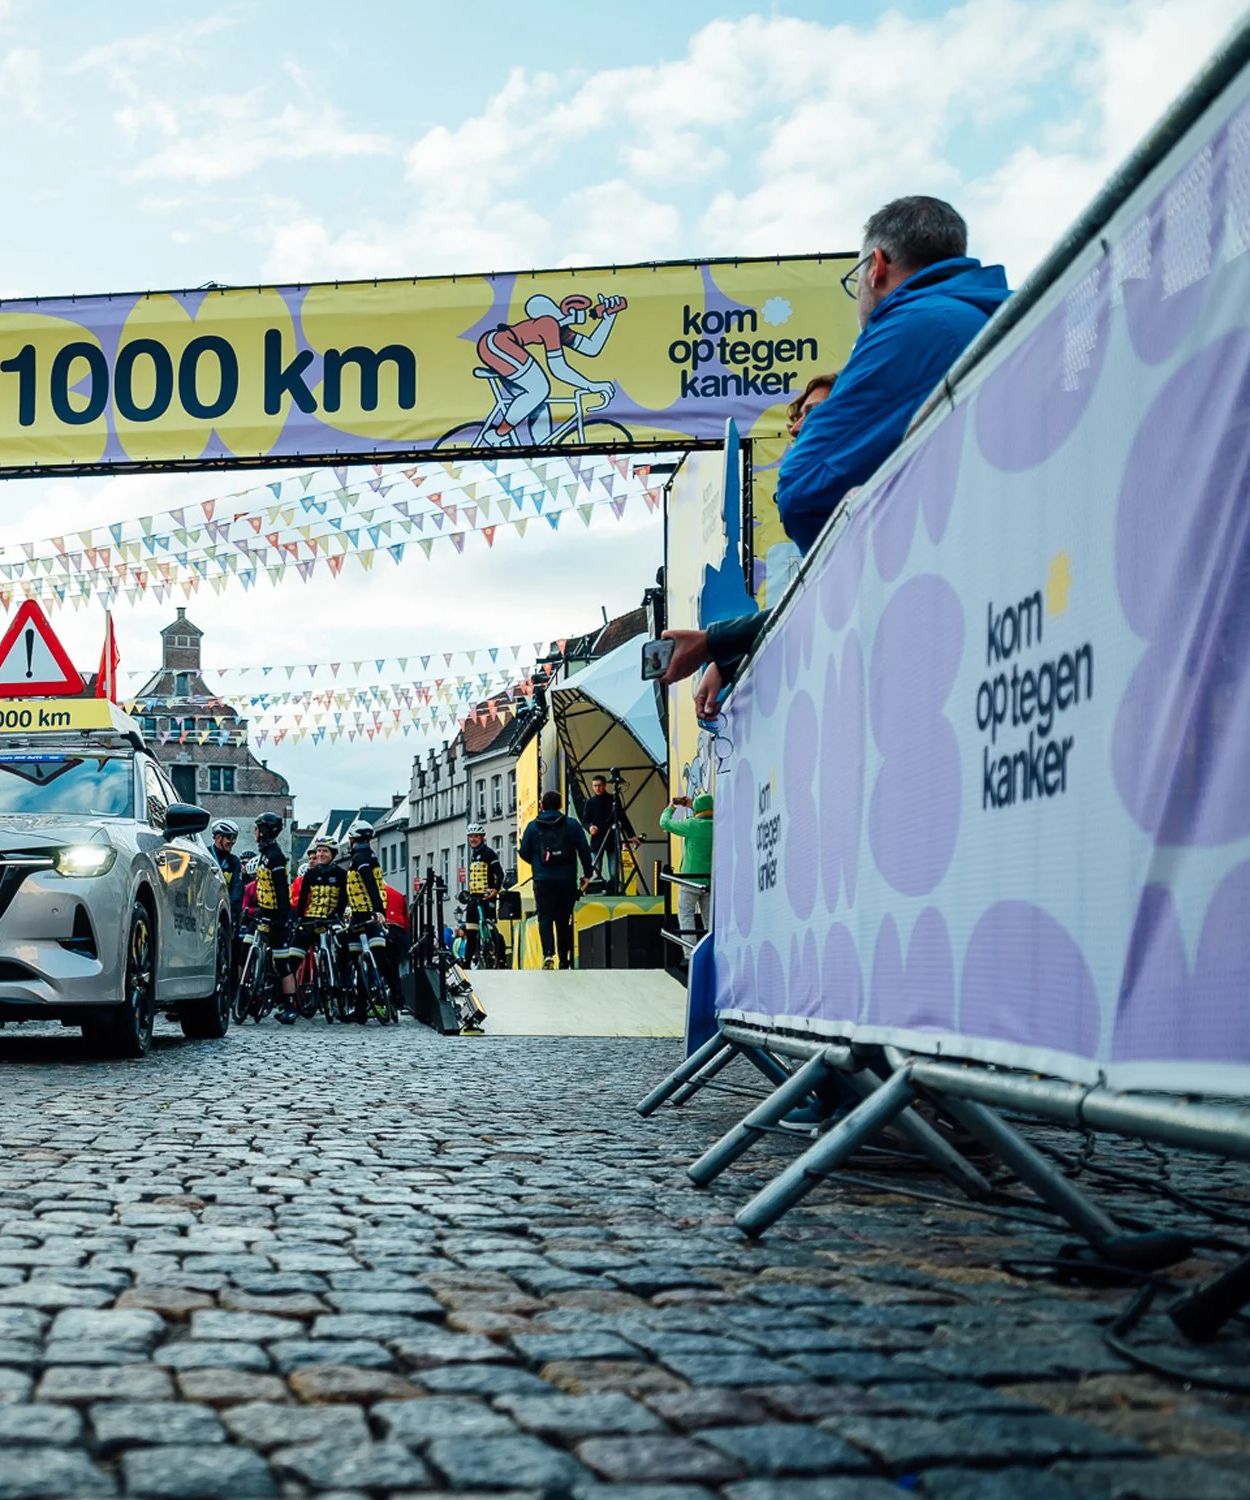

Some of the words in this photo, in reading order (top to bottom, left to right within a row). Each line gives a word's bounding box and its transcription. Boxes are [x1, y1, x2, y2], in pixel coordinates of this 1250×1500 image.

[683, 304, 758, 336] kom
[0, 335, 239, 426] 1000
[264, 328, 417, 416] km
[681, 366, 798, 399] kanker
[987, 589, 1043, 667] kom
[39, 708, 71, 727] km
[983, 730, 1074, 811] kanker
